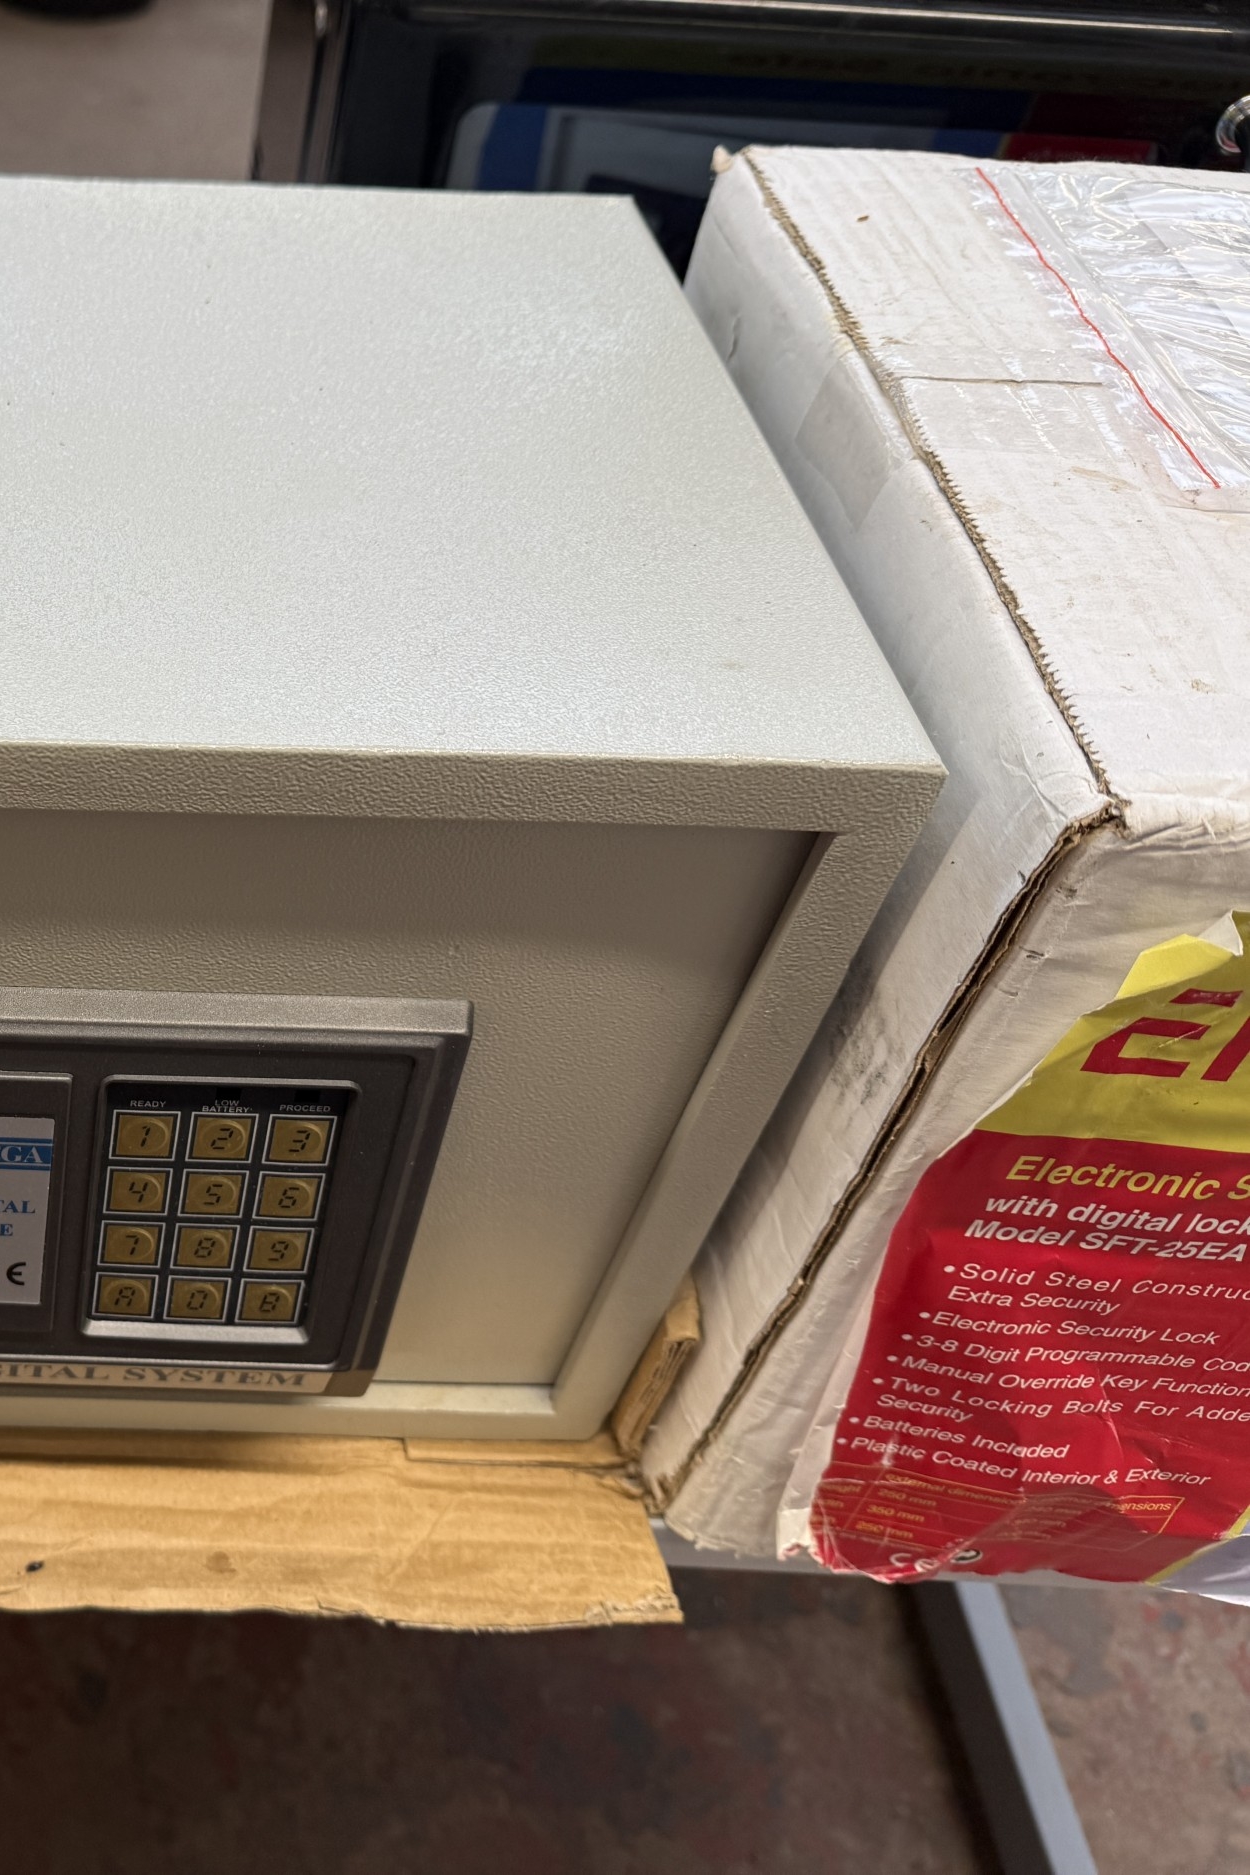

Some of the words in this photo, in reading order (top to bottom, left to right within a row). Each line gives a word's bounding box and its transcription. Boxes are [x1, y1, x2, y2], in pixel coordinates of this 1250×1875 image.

[129, 1100, 166, 1108] READY
[201, 1105, 250, 1113] BATTERY
[279, 1104, 332, 1113] PROCEED
[210, 1127, 234, 1150] 2
[288, 1130, 311, 1153] 3
[1005, 1155, 1221, 1200] Electronic
[128, 1181, 149, 1203] 4
[203, 1184, 224, 1206] 5
[277, 1186, 300, 1209] 6
[985, 1195, 1059, 1218] with
[1067, 1202, 1182, 1233] digital
[125, 1234, 140, 1256] 7
[193, 1237, 216, 1259] 8
[267, 1240, 290, 1262] 9
[964, 1219, 1077, 1246] Model
[1079, 1232, 1248, 1262] SFT-25EA
[959, 1263, 1035, 1286] Solid
[1045, 1271, 1122, 1293] Steel
[948, 1285, 1013, 1307] Extra
[1020, 1292, 1121, 1316] Security
[932, 1311, 1051, 1335] Electronic
[1057, 1320, 1156, 1343] Security
[1160, 1327, 1221, 1345] Lock
[916, 1335, 959, 1353] 3-8
[963, 1343, 1021, 1364] Digit
[1025, 1346, 1196, 1369] Programmable
[122, 1366, 306, 1387] SYSTEM
[901, 1355, 994, 1385] Manual
[999, 1374, 1095, 1389] Override
[1101, 1374, 1148, 1392] Key
[877, 1394, 974, 1423] Security
[890, 1376, 941, 1397] Two
[951, 1389, 1053, 1418] Locking
[1062, 1399, 1124, 1415] Bolts
[1134, 1401, 1180, 1417] For
[863, 1415, 967, 1444] Batteries
[971, 1434, 1071, 1458] Included
[850, 1436, 927, 1460] Plastic
[931, 1451, 1018, 1478] Coated
[1022, 1469, 1101, 1485] Interior
[1103, 1469, 1119, 1485] &
[1125, 1468, 1212, 1486] Exterior
